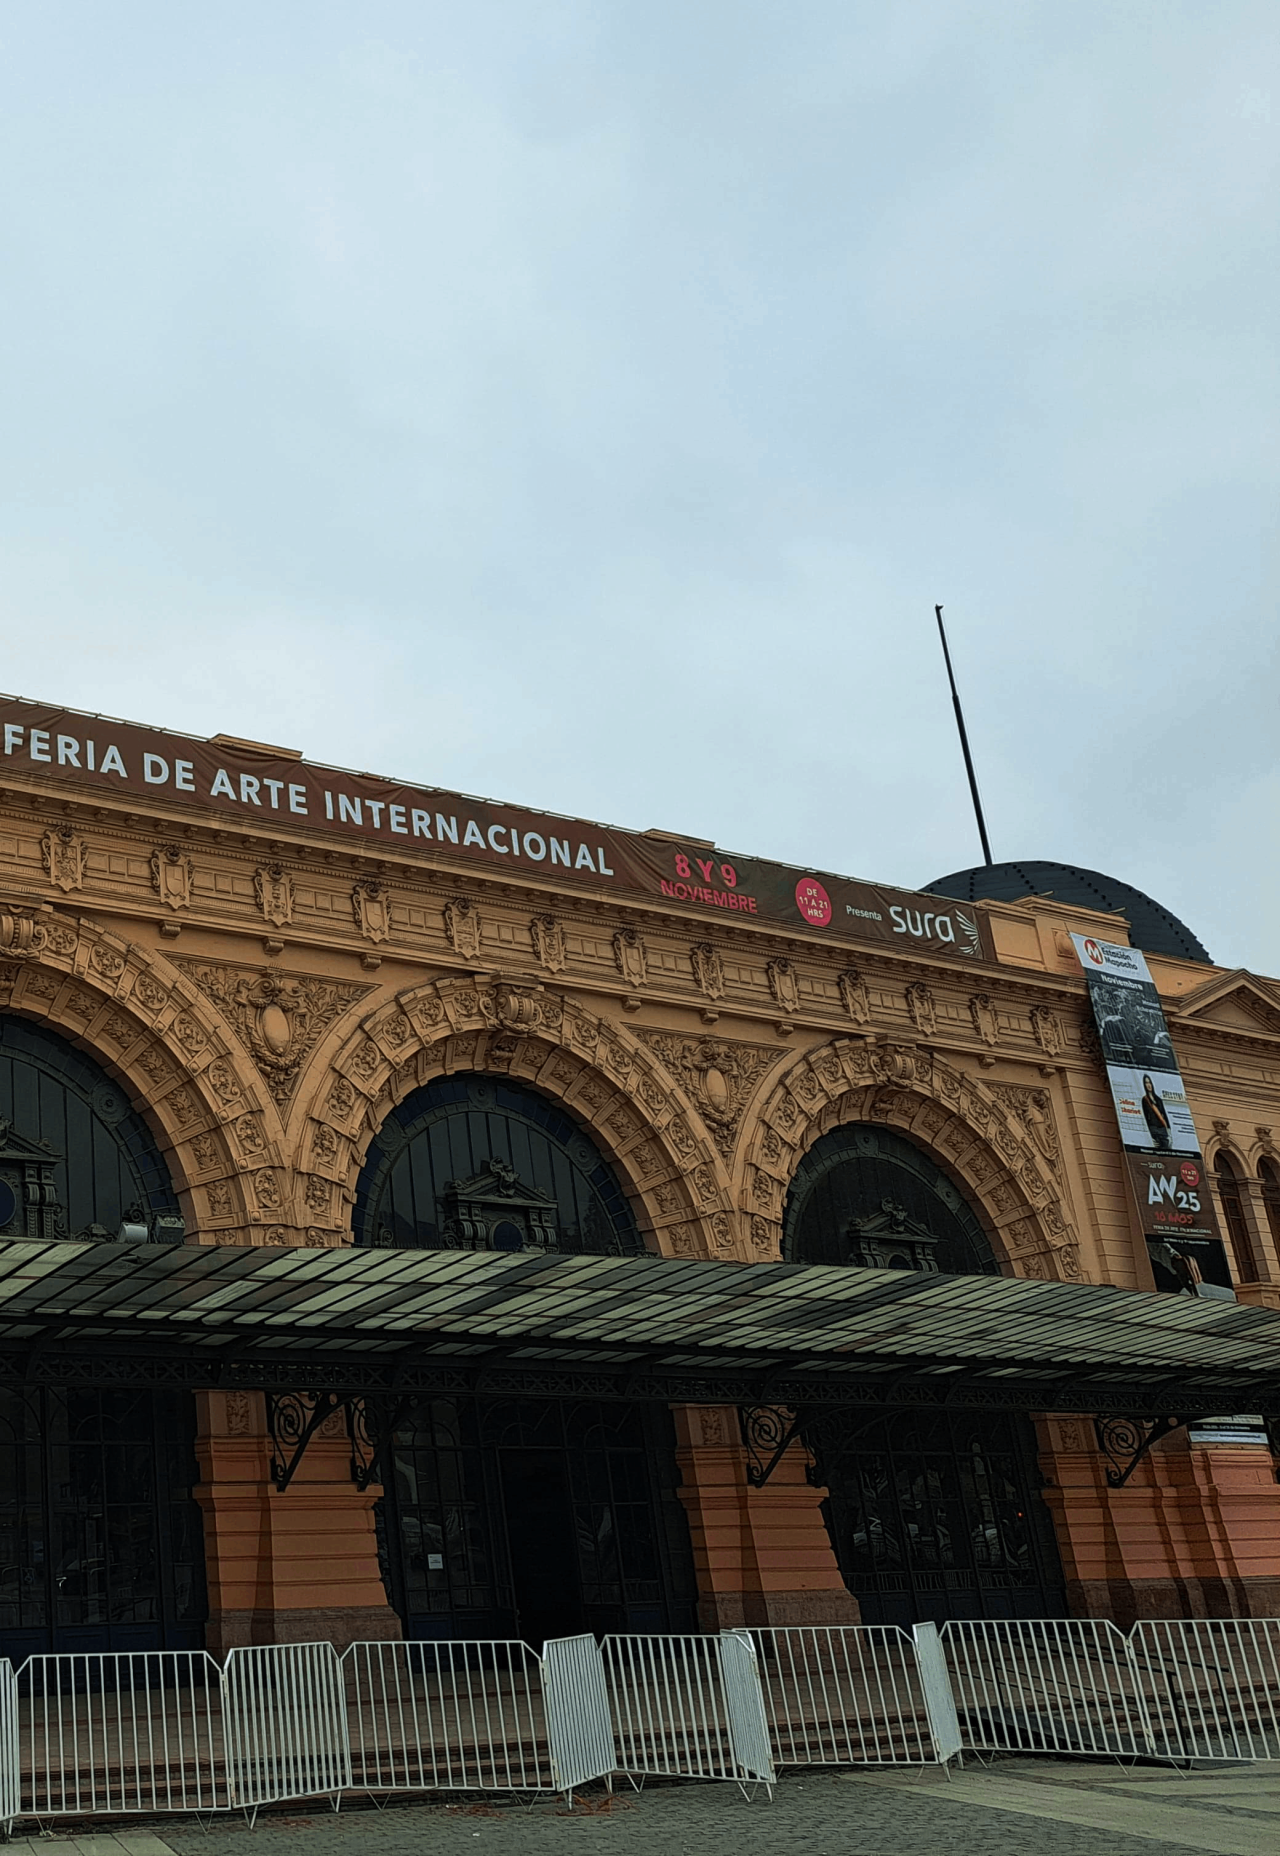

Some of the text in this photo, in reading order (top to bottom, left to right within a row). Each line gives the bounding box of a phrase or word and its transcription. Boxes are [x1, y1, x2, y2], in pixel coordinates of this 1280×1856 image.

[3, 722, 614, 876] FERIA DE ARTE INTERNACIONAL
[674, 853, 737, 888] 8 Y 9
[660, 879, 758, 913] NOVIEMBRE
[806, 887, 818, 898] DE
[799, 896, 809, 906] 11
[819, 900, 828, 909] 21
[807, 908, 824, 918] HRS
[846, 905, 882, 921] Presenta
[889, 906, 955, 944] sura
[1101, 947, 1132, 960] Estación
[1101, 974, 1143, 991] Noviembre
